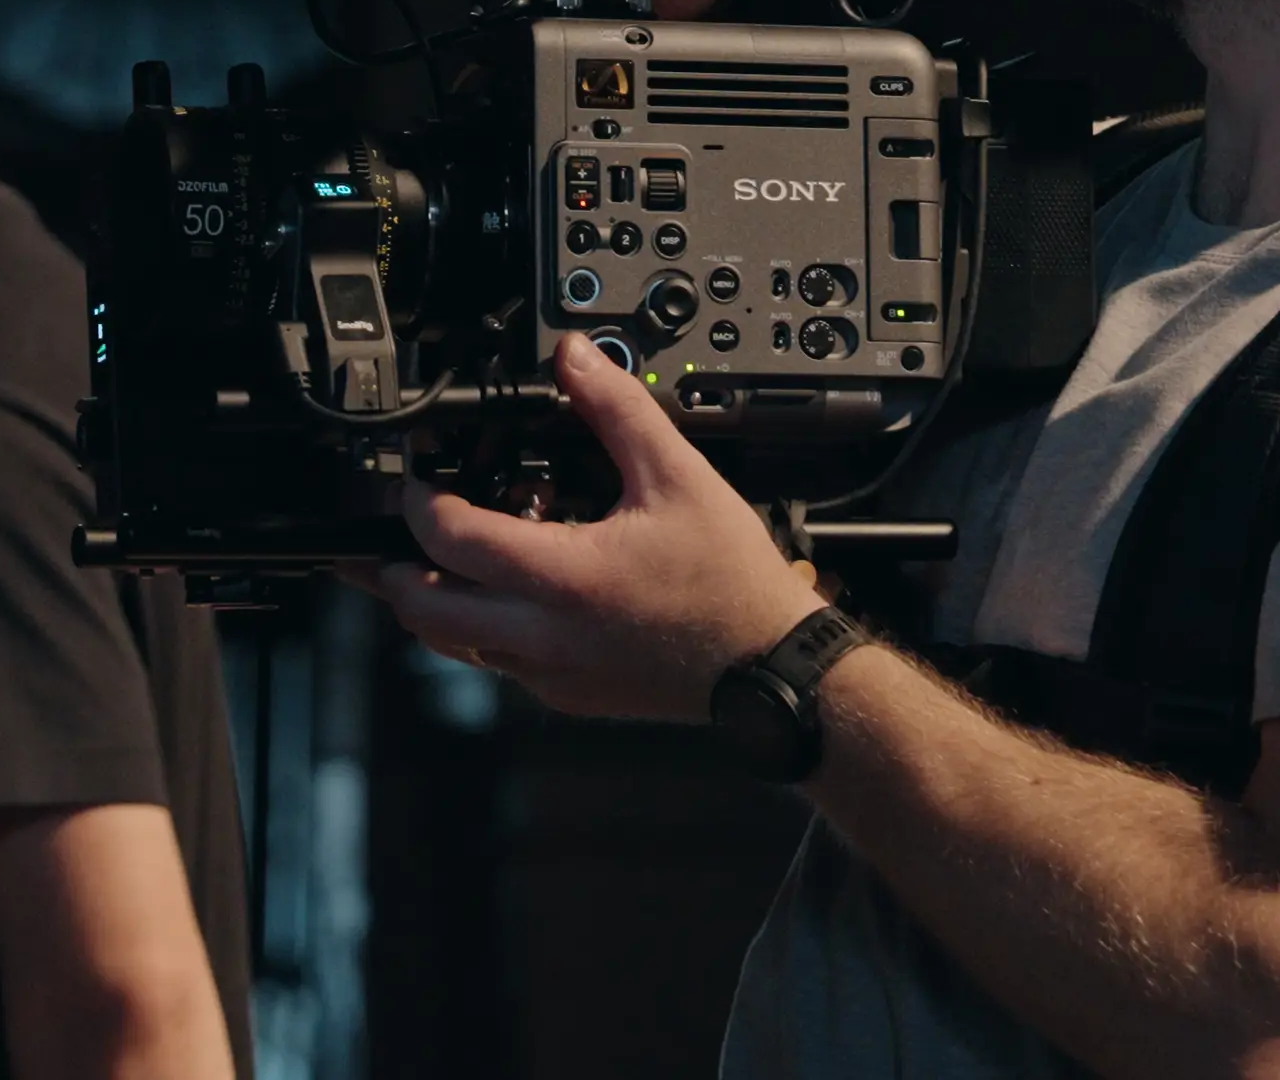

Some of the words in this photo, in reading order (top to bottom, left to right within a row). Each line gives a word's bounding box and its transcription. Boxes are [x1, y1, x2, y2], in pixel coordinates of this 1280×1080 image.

[879, 82, 905, 92] CLIPS
[886, 143, 894, 153] A
[733, 177, 846, 202] SONY
[183, 204, 225, 236] 50
[578, 233, 585, 245] 1
[621, 233, 630, 246] 2
[660, 236, 681, 245] DISP
[770, 259, 792, 268] AUTO
[712, 280, 735, 289] MENU
[770, 312, 792, 320] AUTO
[712, 332, 736, 341] BACK
